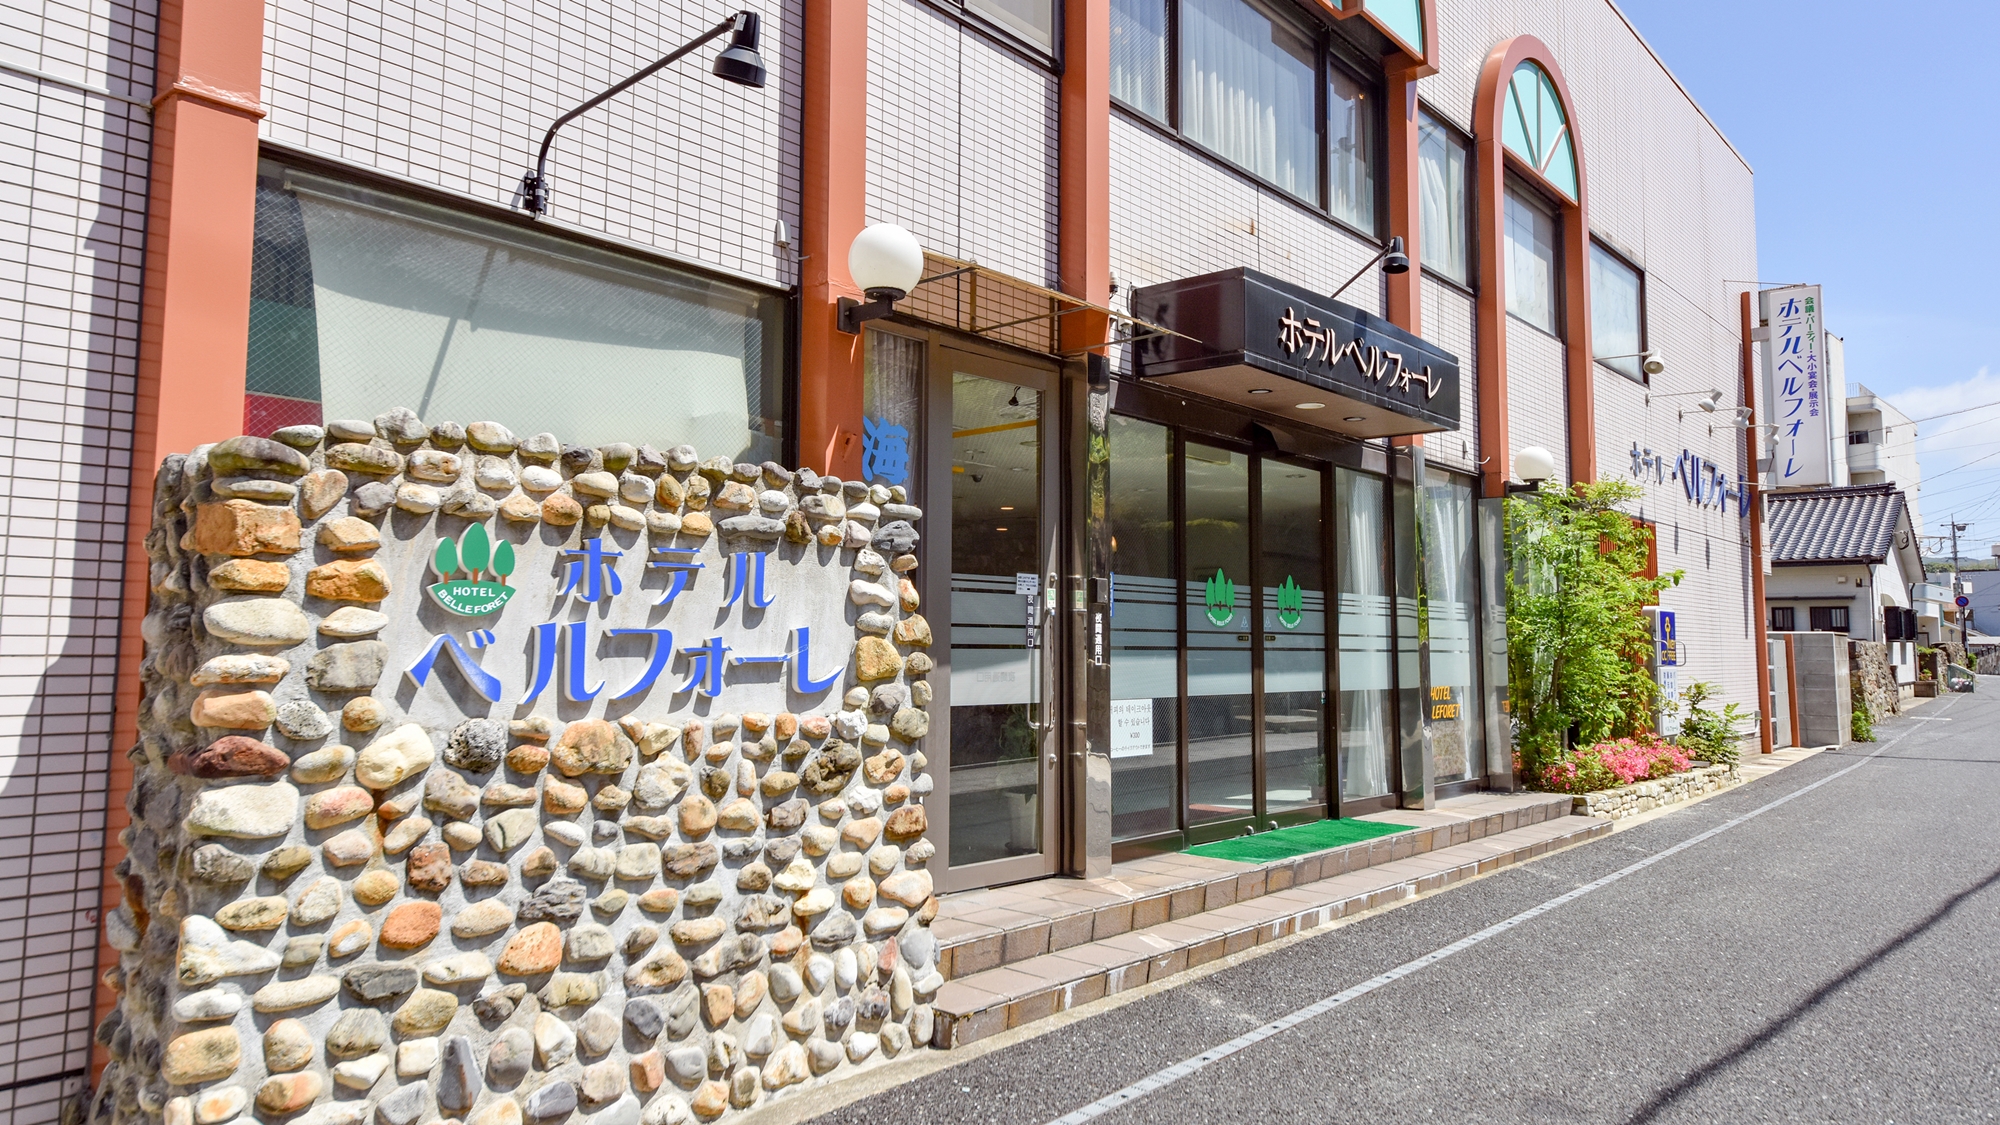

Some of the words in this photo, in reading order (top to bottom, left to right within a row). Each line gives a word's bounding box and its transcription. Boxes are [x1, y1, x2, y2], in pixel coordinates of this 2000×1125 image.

[1278, 306, 1442, 399] ホテルベルフォーレ
[453, 587, 496, 597] HOTEL
[557, 537, 776, 608] ホテル
[404, 621, 844, 705] ベルフォーレ
[1111, 705, 1123, 714] 피의
[1430, 685, 1451, 700] HOTEL
